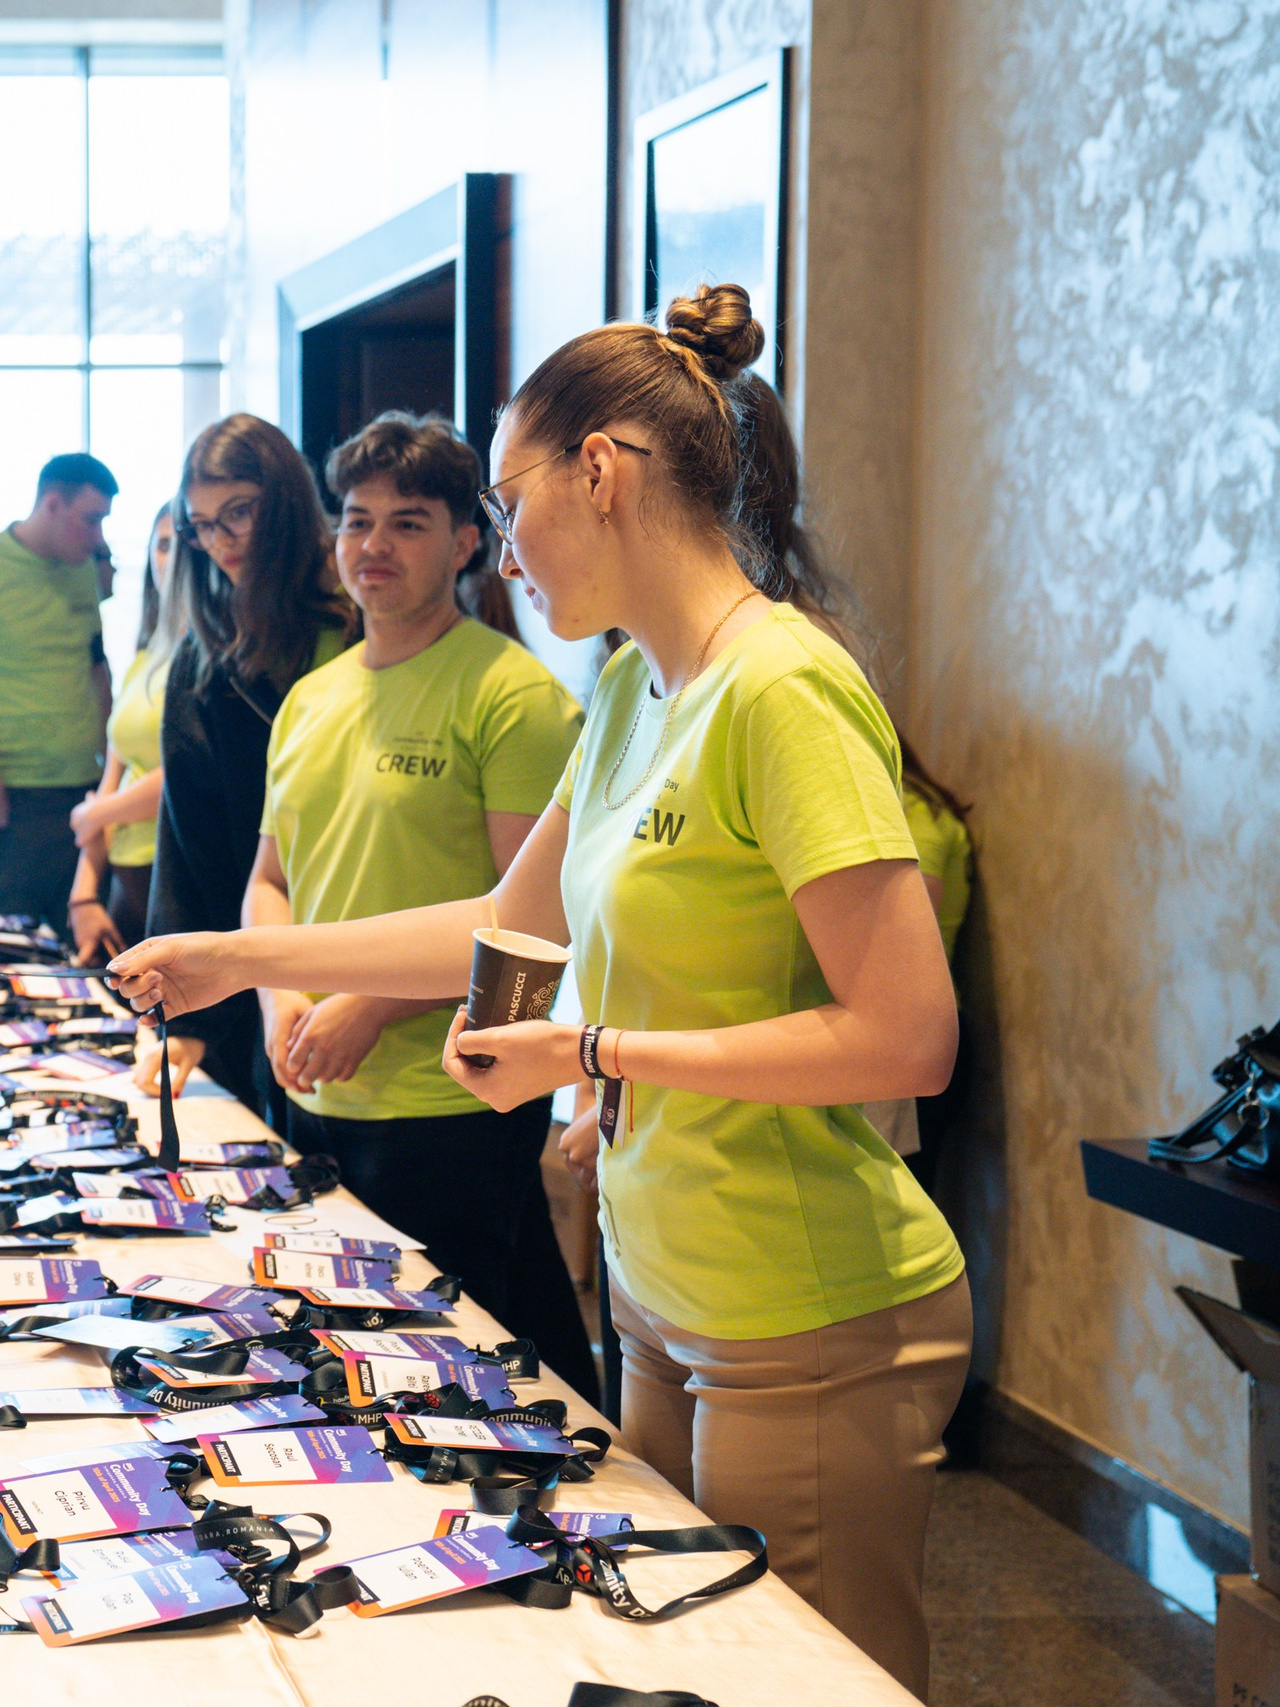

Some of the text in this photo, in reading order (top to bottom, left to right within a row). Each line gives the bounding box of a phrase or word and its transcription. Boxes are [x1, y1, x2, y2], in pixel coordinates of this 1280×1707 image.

[376, 753, 447, 778] CREW
[664, 778, 680, 792] Day
[633, 807, 686, 846] EW
[508, 972, 527, 1022] PASCUCCI
[359, 1363, 372, 1393] PARTICIPANT
[465, 1365, 479, 1394] Community
[358, 1412, 383, 1424] MHP
[214, 1444, 236, 1472] PARTICIPANT
[262, 1443, 281, 1468] Secosan
[281, 1447, 297, 1461] Raul
[323, 1429, 352, 1472] Community Day
[54, 1490, 76, 1516] Ciprian
[71, 1490, 90, 1510] Pirvu
[108, 1463, 150, 1516] Community Day
[1, 1494, 31, 1530] PARTICIPANT
[451, 1534, 488, 1561] Community
[482, 1558, 500, 1571] Day
[556, 1568, 572, 1585] ay
[40, 1601, 69, 1630] PARTICIPANT
